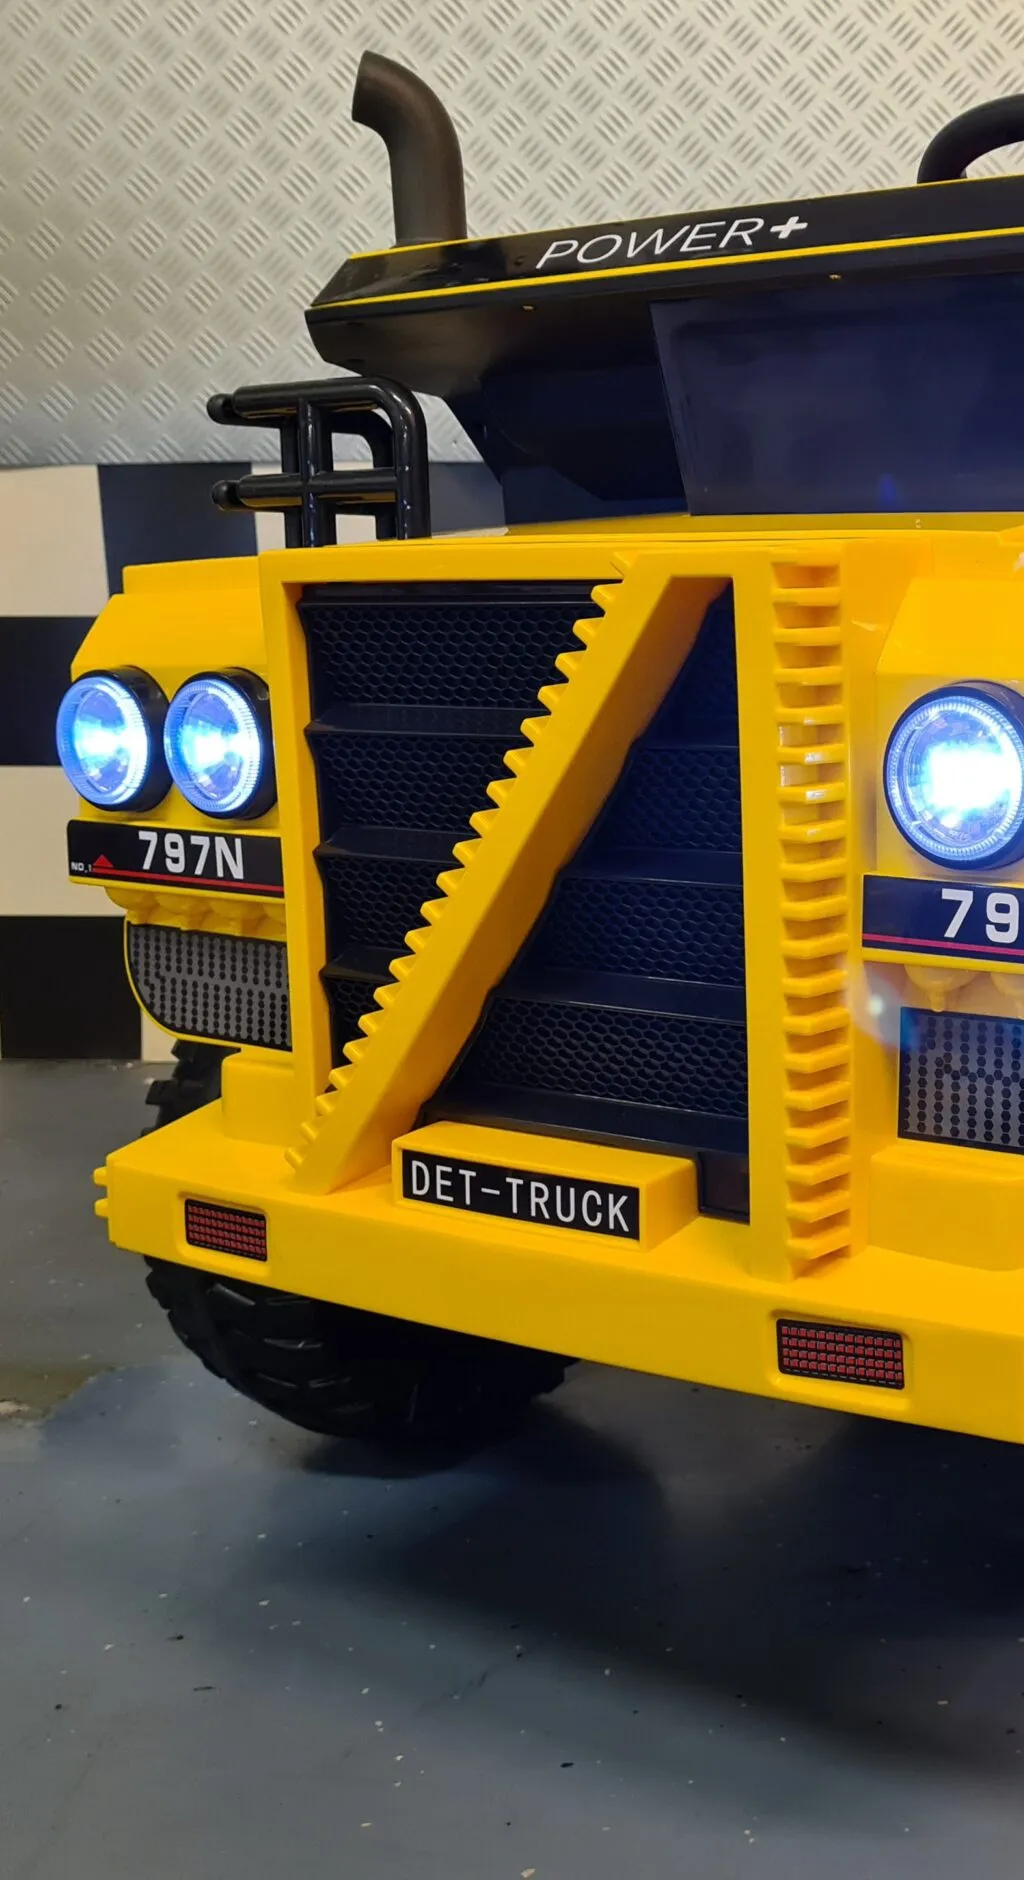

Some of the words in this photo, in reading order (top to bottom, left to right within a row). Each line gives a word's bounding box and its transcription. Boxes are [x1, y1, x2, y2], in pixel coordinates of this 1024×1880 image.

[534, 215, 809, 270] POWER+
[138, 830, 245, 880] 797N
[411, 1159, 630, 1233] DET-TRUCK
